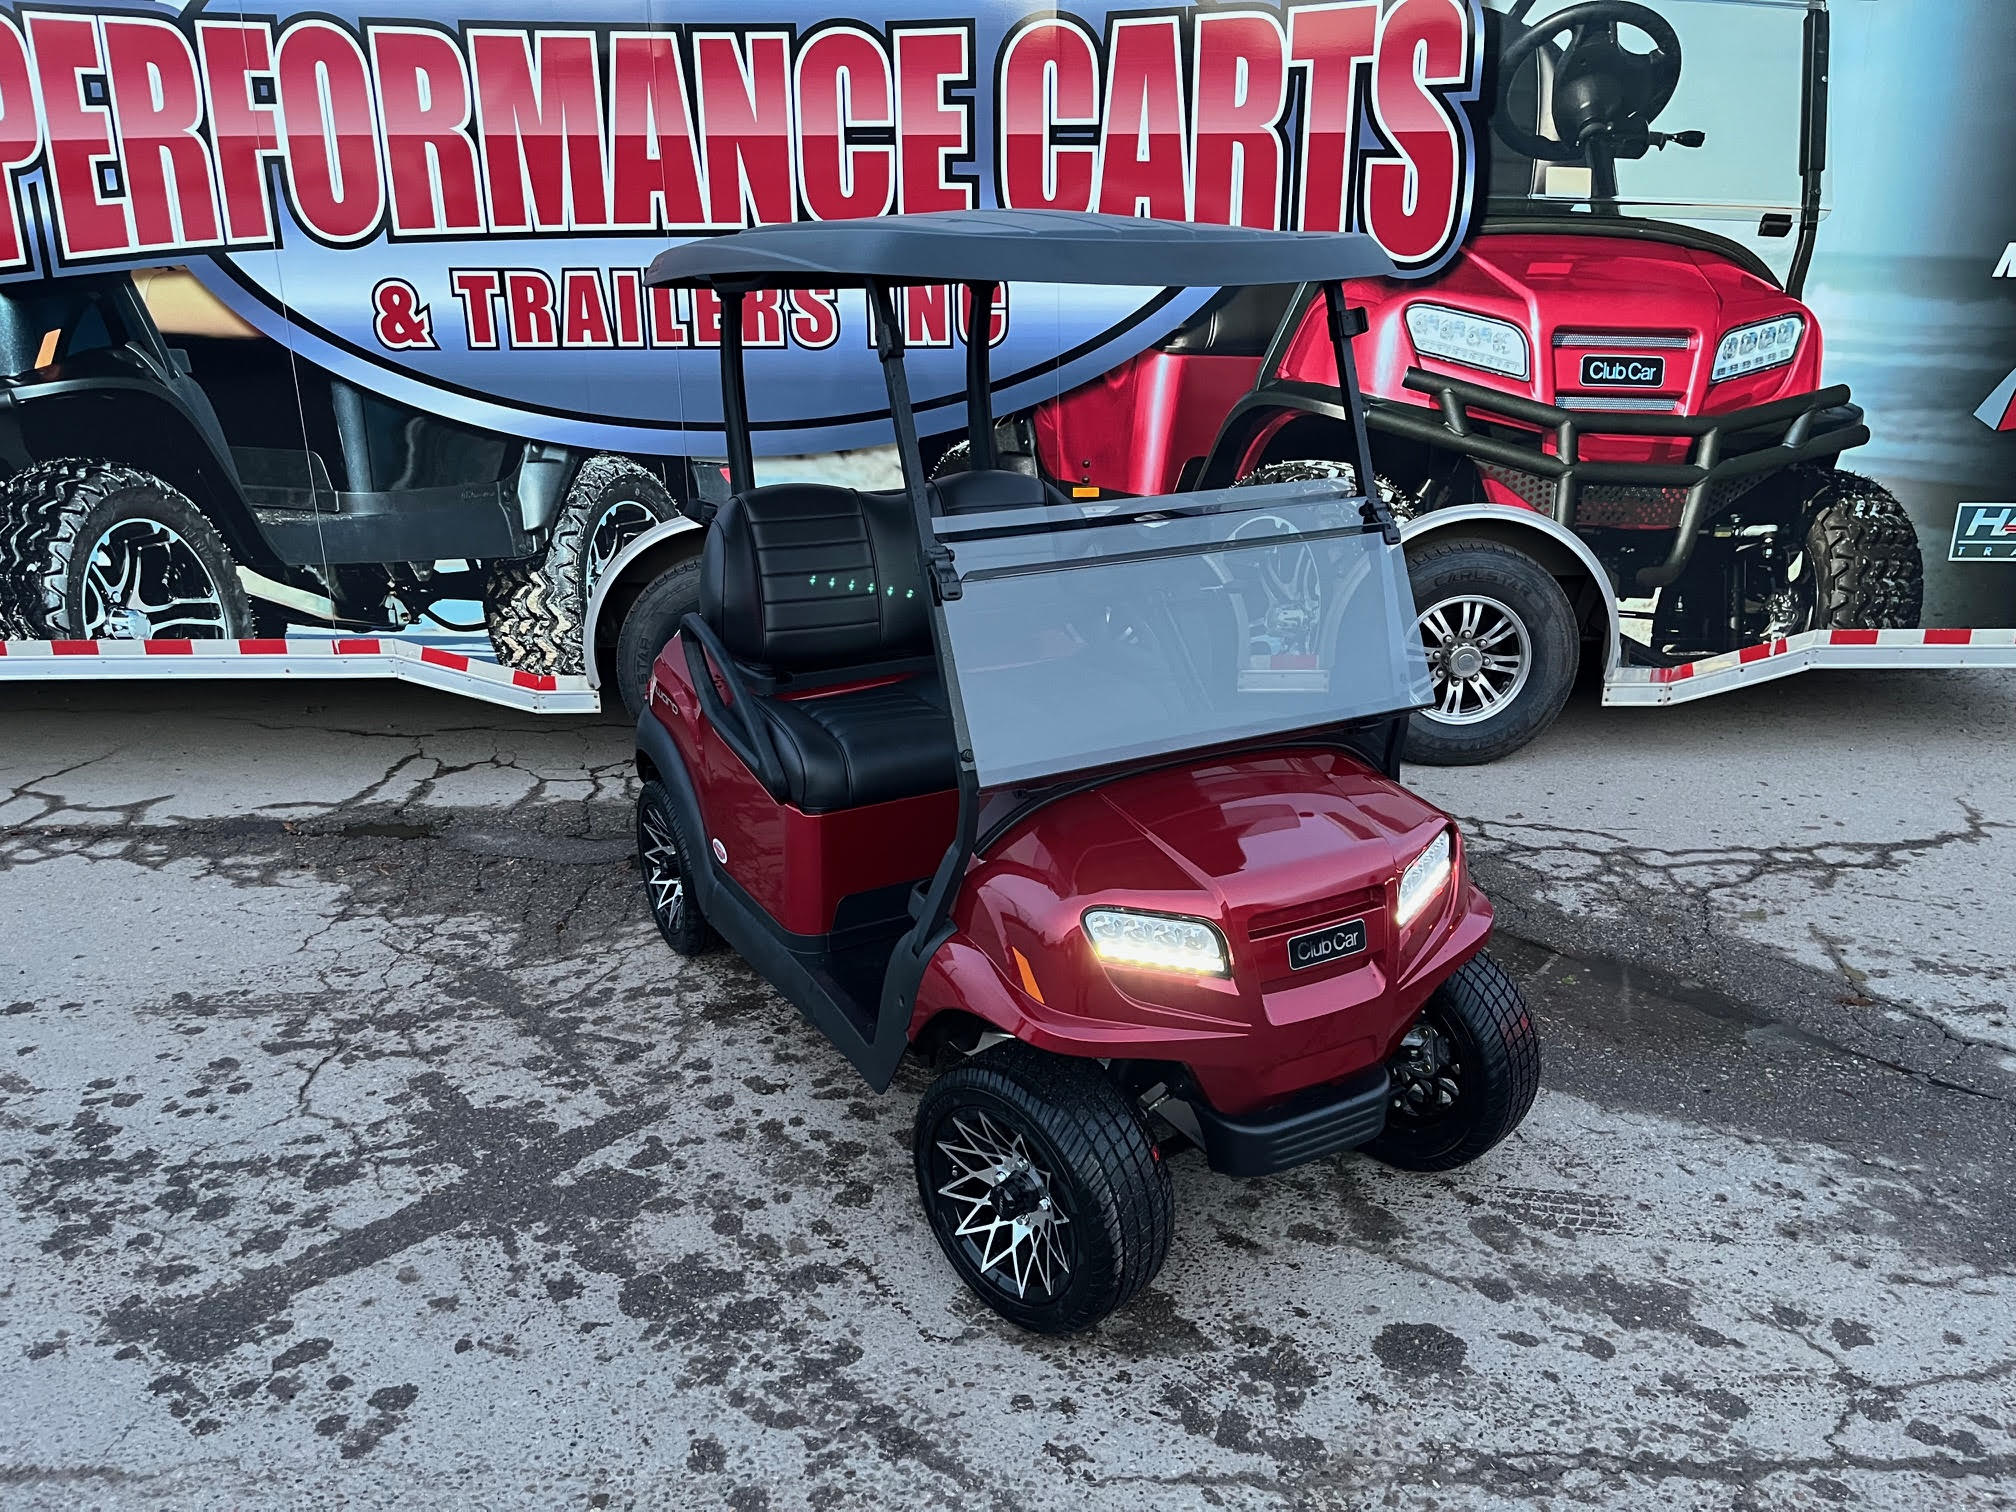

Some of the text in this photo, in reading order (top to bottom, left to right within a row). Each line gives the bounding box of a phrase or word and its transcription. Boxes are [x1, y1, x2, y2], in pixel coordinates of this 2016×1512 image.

[1001, 0, 1467, 263] CARTS
[376, 279, 436, 348] &
[1590, 361, 1656, 380] Club Car
[1298, 932, 1359, 960] Club Car
